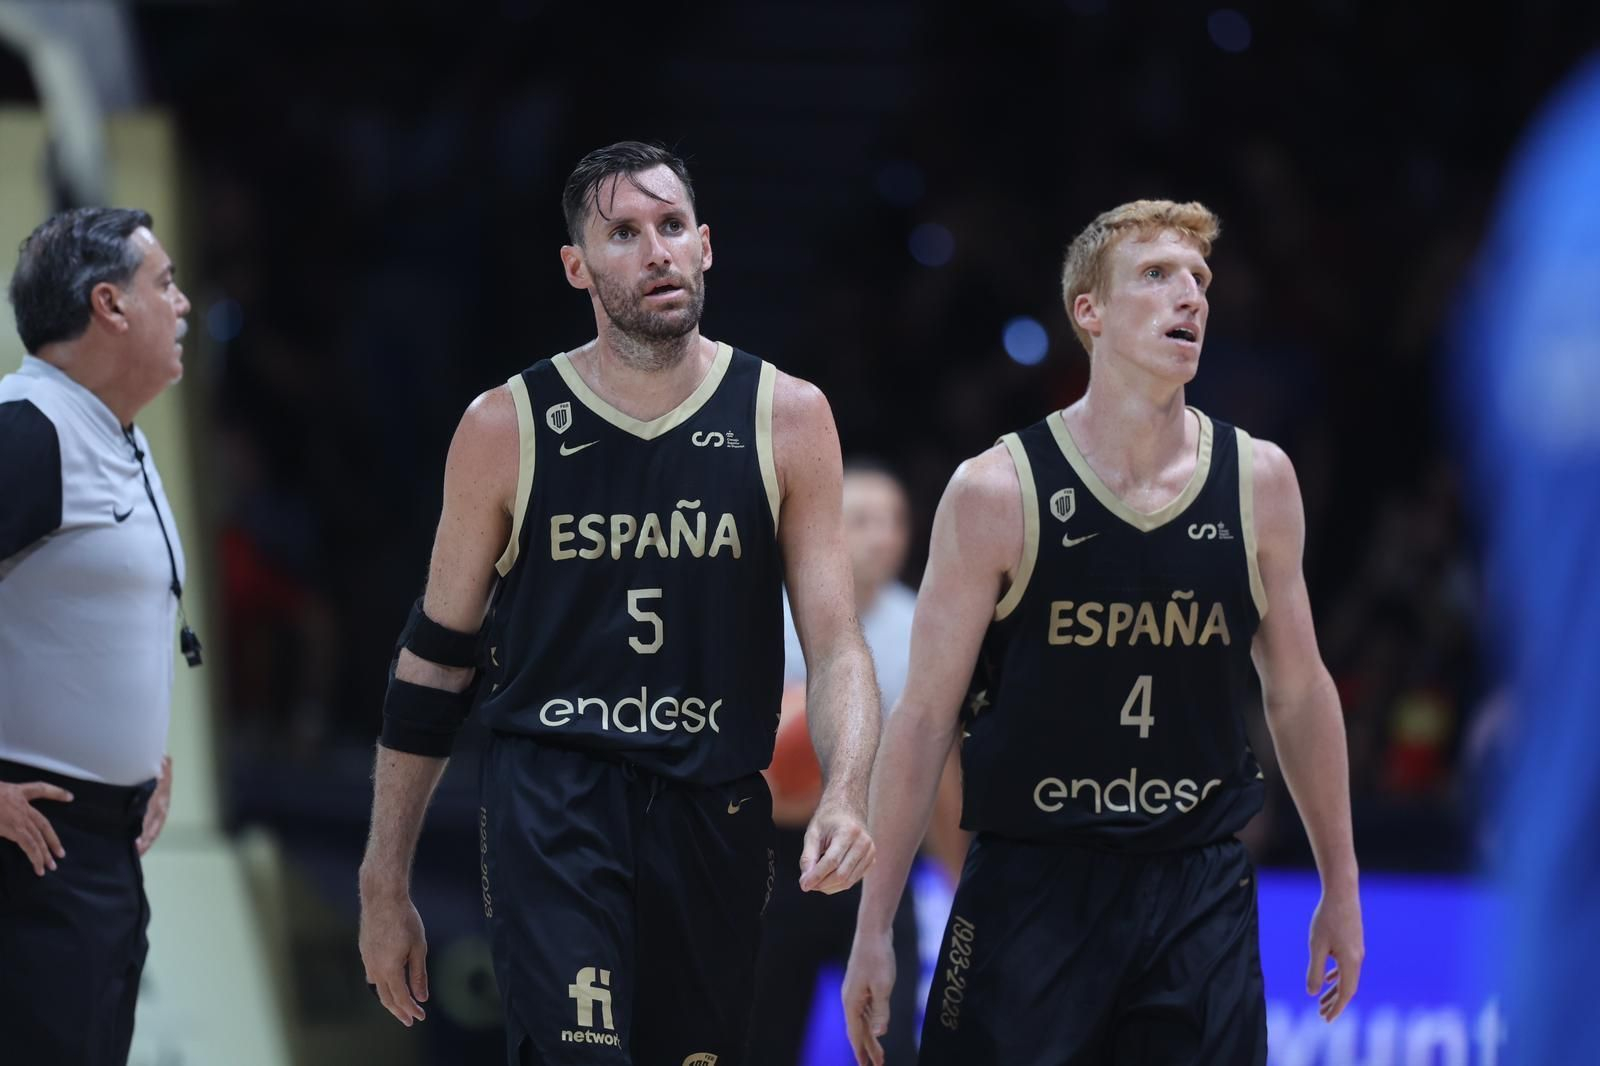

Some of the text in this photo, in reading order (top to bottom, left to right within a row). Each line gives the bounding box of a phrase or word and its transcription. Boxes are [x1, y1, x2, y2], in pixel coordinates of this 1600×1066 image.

[550, 499, 741, 561] ESPAÑA
[627, 588, 664, 654] 5
[1048, 590, 1231, 647] ESPAÑA
[1120, 675, 1155, 739] 4
[568, 966, 615, 1030] fi
[940, 915, 975, 1030] 1923-2023
